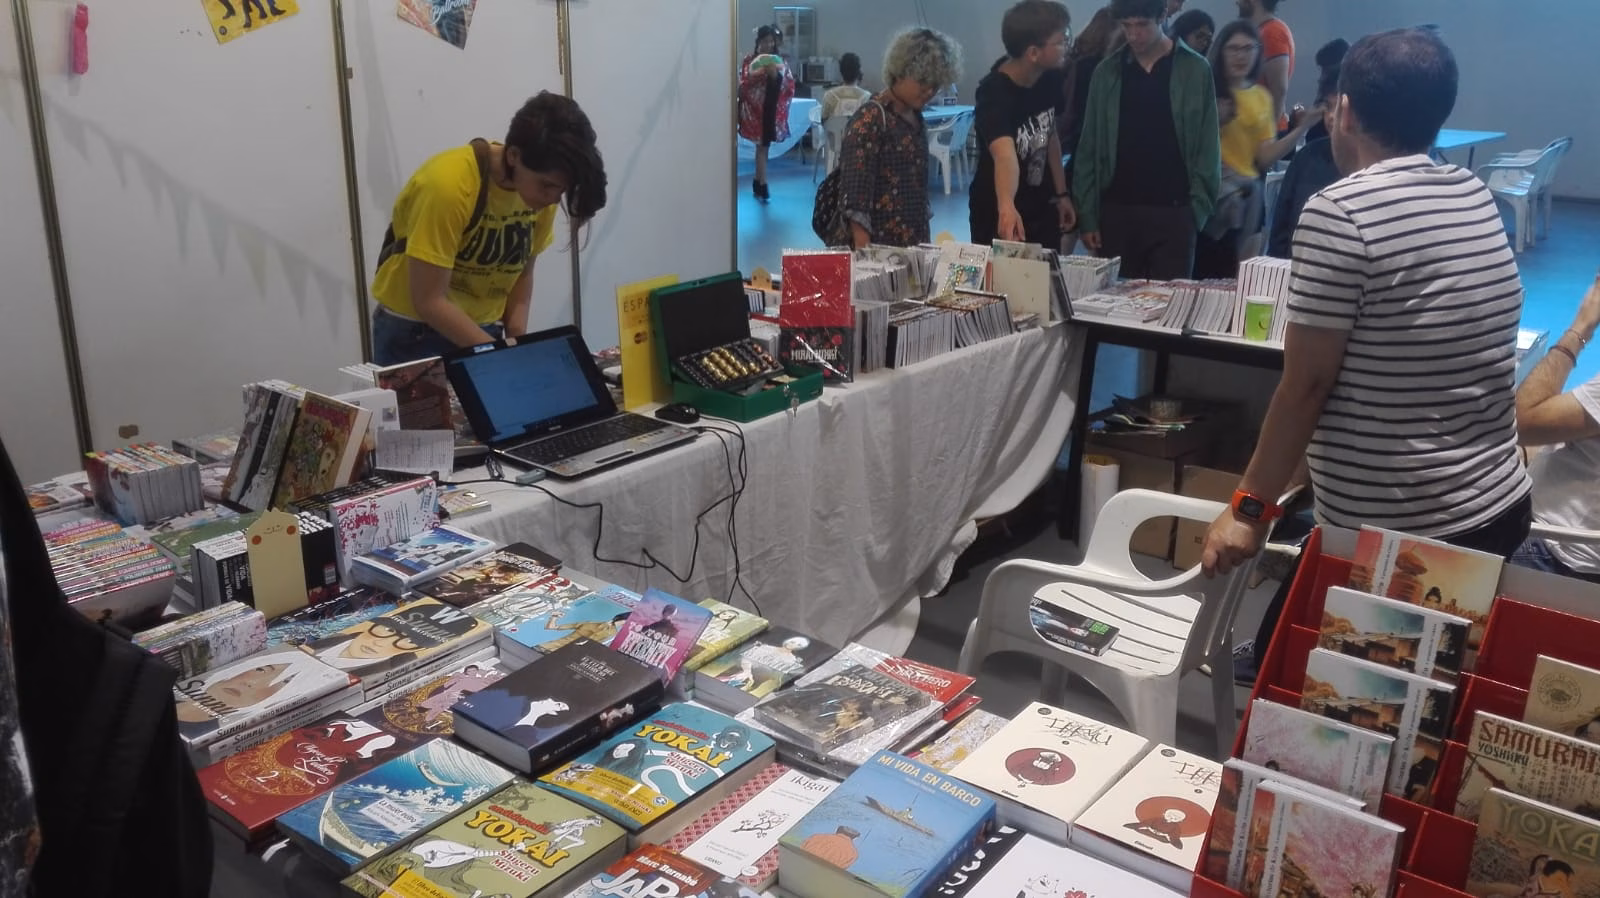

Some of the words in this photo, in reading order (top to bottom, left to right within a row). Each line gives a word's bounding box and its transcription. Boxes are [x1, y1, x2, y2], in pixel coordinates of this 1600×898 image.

[216, 722, 247, 740] Sunny
[233, 727, 264, 746] Sunny
[635, 724, 731, 768] YOKAI
[1479, 720, 1600, 776] SAMURAI
[256, 770, 279, 783] 2
[664, 758, 700, 780] Mizuki
[668, 750, 706, 774] Shigeru
[877, 755, 893, 766] MI
[893, 759, 921, 778] VIDA
[922, 773, 940, 786] EN
[940, 781, 983, 807] BARCO
[465, 810, 570, 868] YOKAI
[1502, 803, 1600, 858] YOKA
[492, 857, 530, 883] Mizuki
[500, 849, 540, 877] Shigeru
[636, 855, 660, 869] Marc
[658, 864, 699, 887] Bernabé
[591, 868, 698, 898] JAP
